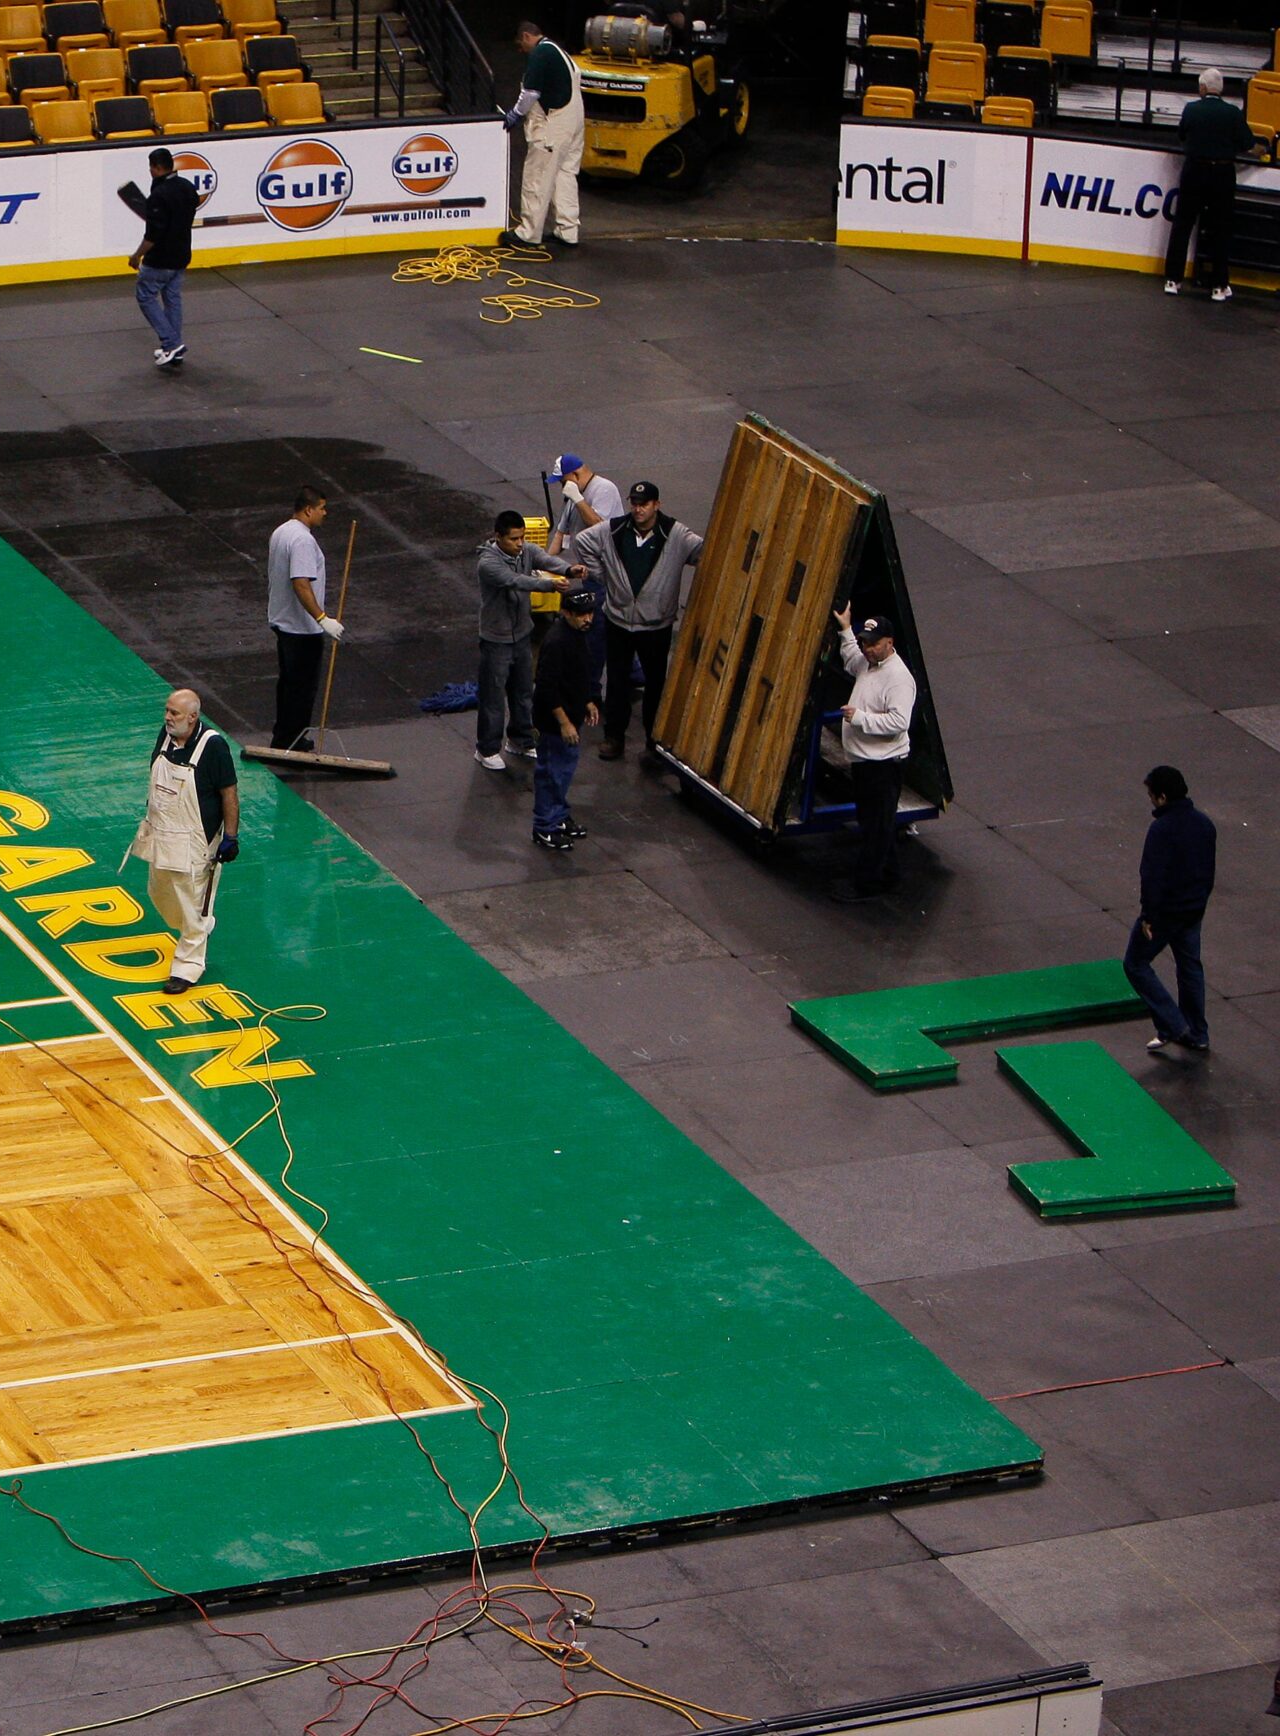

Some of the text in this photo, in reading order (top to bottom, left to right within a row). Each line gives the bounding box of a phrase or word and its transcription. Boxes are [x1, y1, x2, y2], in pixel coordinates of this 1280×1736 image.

[395, 156, 454, 175] Gulf
[192, 173, 214, 191] lf
[259, 171, 347, 201] Gulf
[1040, 172, 1182, 222] NHL.CO
[372, 208, 471, 223] www.gulfoil.com
